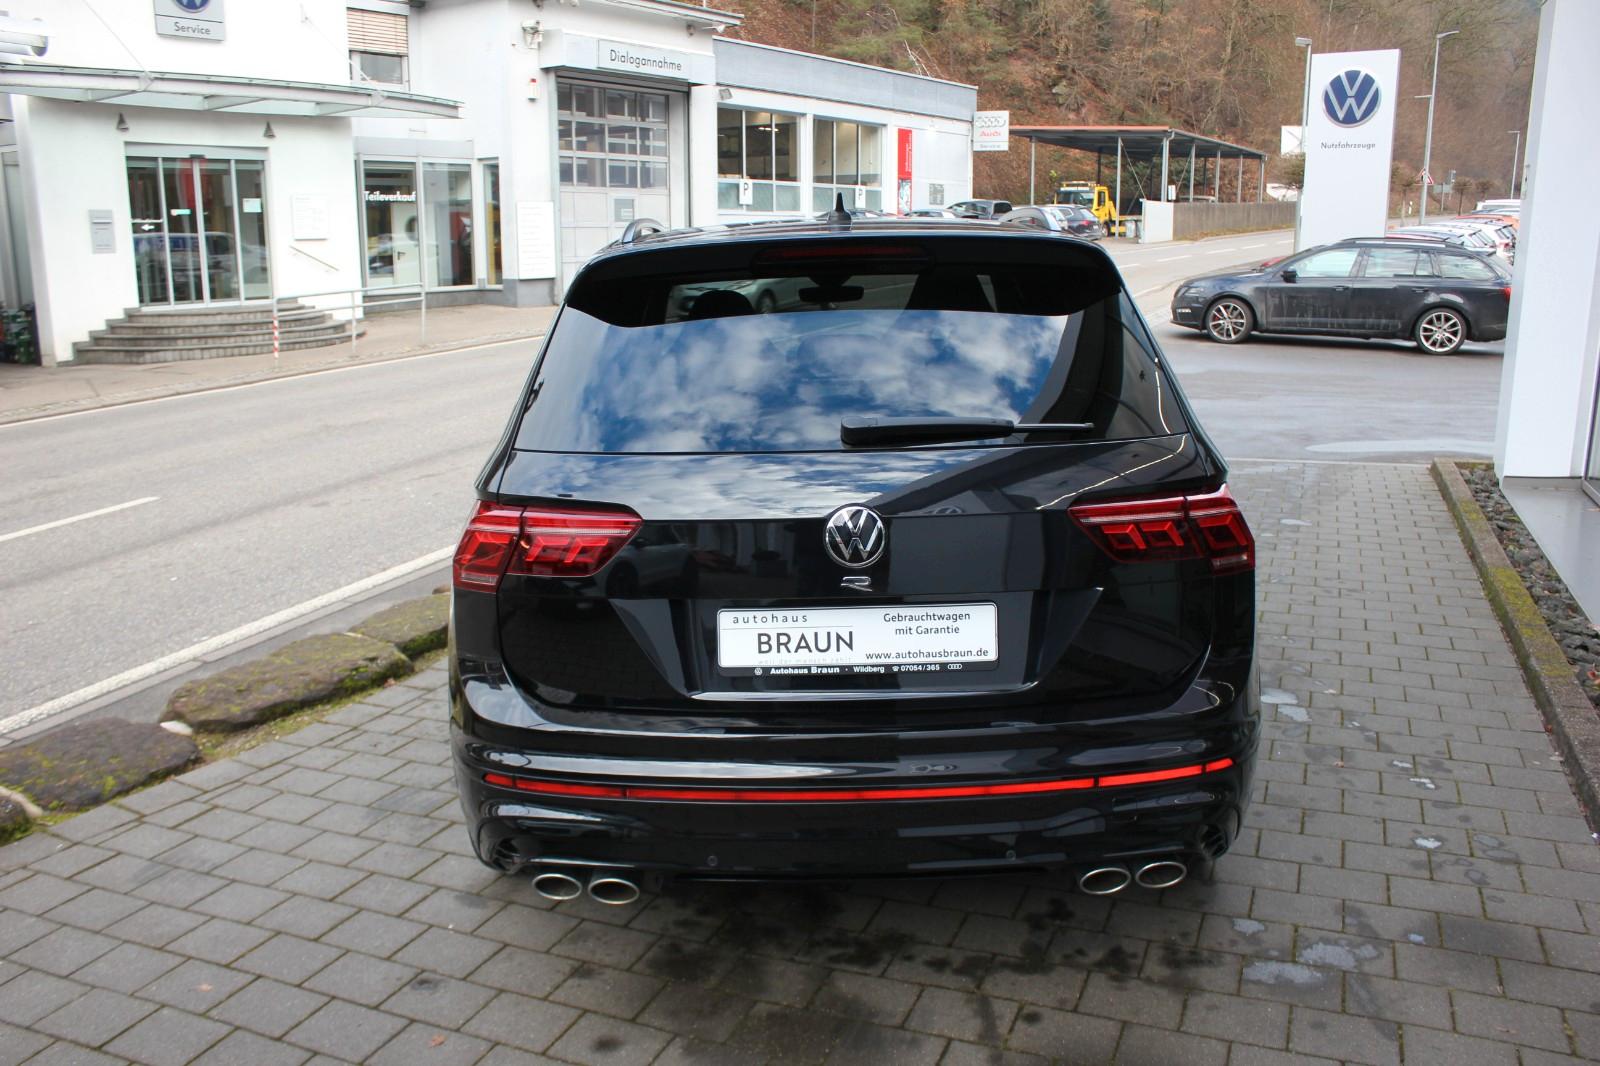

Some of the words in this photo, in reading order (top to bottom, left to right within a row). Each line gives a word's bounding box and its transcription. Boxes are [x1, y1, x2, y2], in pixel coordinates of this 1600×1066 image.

[174, 21, 211, 35] Service
[609, 49, 682, 71] Dialogannahme
[1320, 141, 1376, 151] Nutzfahrzeuge
[743, 182, 750, 196] P
[363, 190, 417, 202] Teileverkauf
[732, 613, 808, 624] autohaus
[883, 611, 971, 623] Gebrauchtwagen
[895, 626, 913, 636] mit
[915, 624, 960, 636] Garantie
[757, 630, 854, 655] BRAUN
[865, 647, 989, 660] www.autohausbraun.de
[770, 667, 809, 675] Autohaus
[810, 666, 840, 674] Braun
[853, 665, 885, 674] Wildberg
